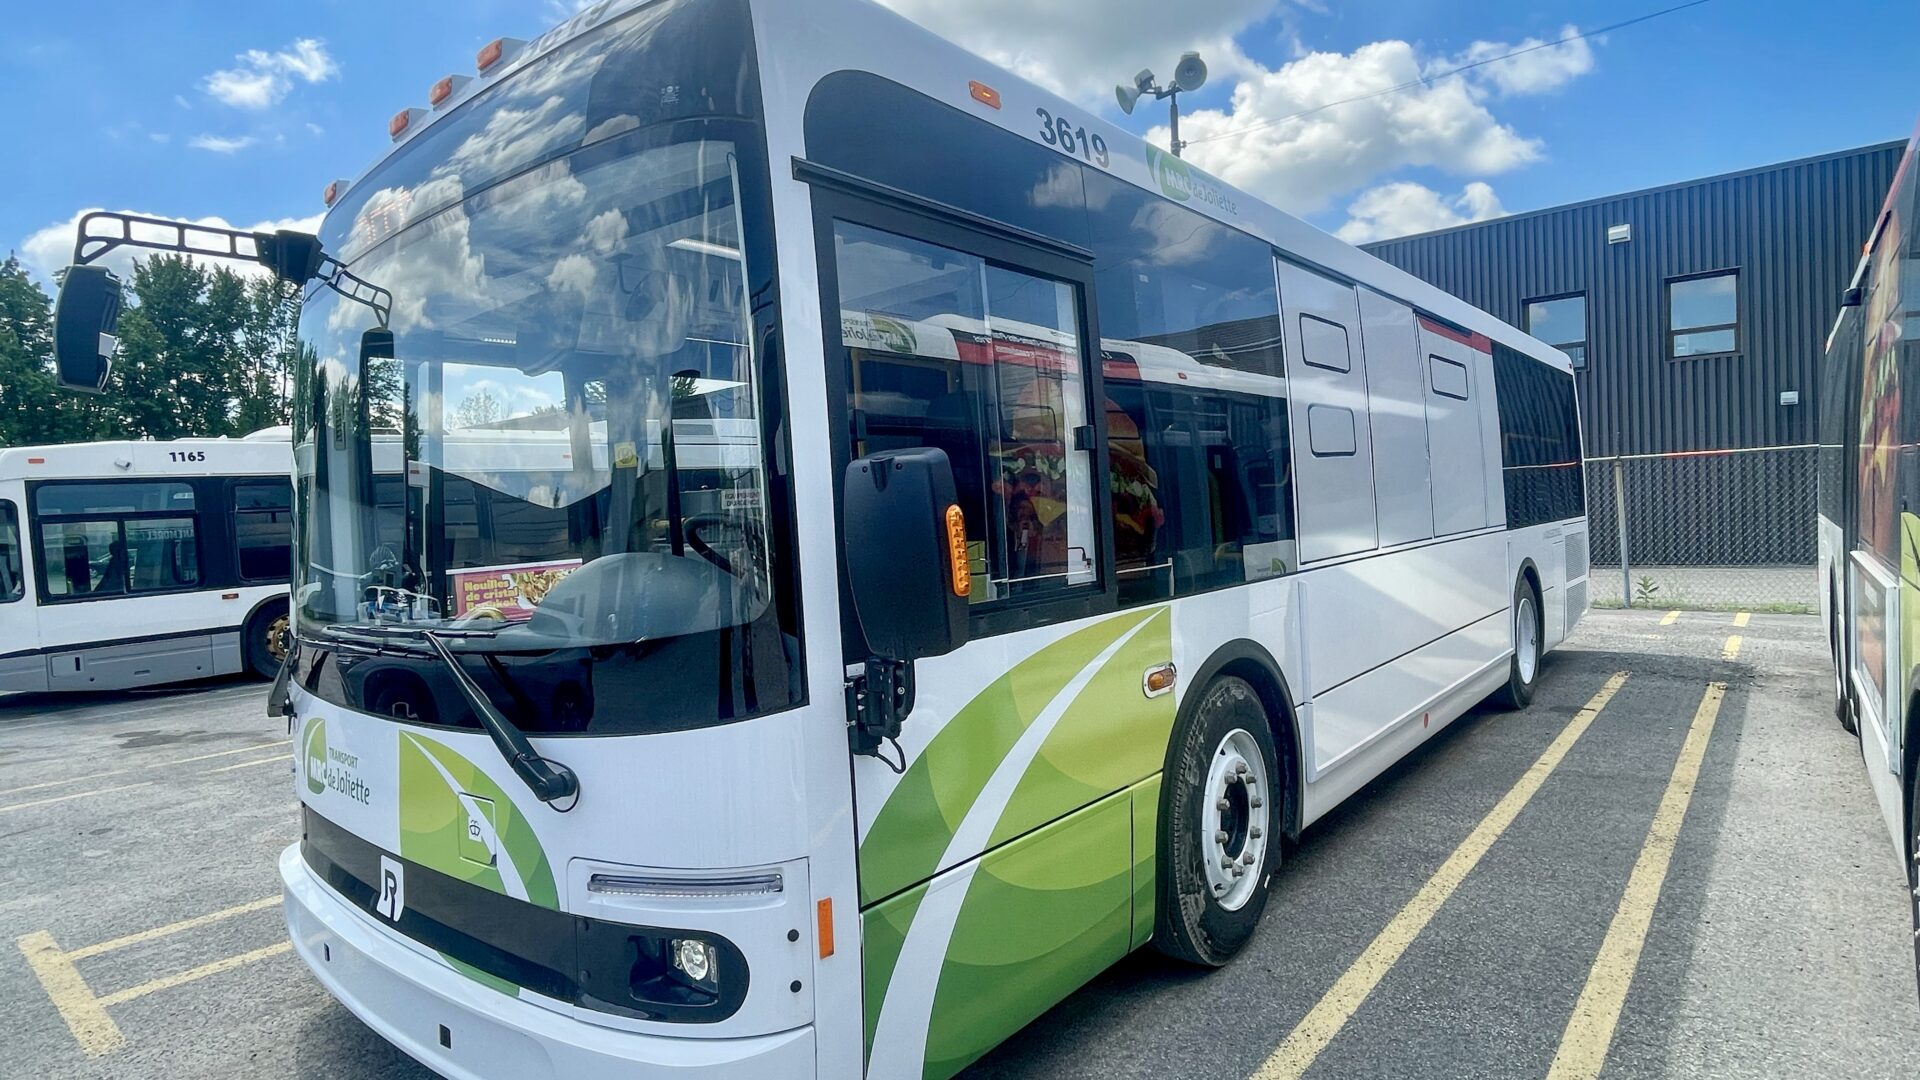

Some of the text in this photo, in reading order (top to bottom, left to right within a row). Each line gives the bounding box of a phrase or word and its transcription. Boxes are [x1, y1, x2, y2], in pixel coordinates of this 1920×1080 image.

[1035, 107, 1110, 169] 3619
[168, 451, 206, 462] 1165
[464, 579, 509, 592] Nouilles
[465, 587, 518, 602] de cristal
[466, 598, 518, 610] Bkok
[329, 747, 359, 768] TRANSPORT
[310, 755, 327, 784] MRC
